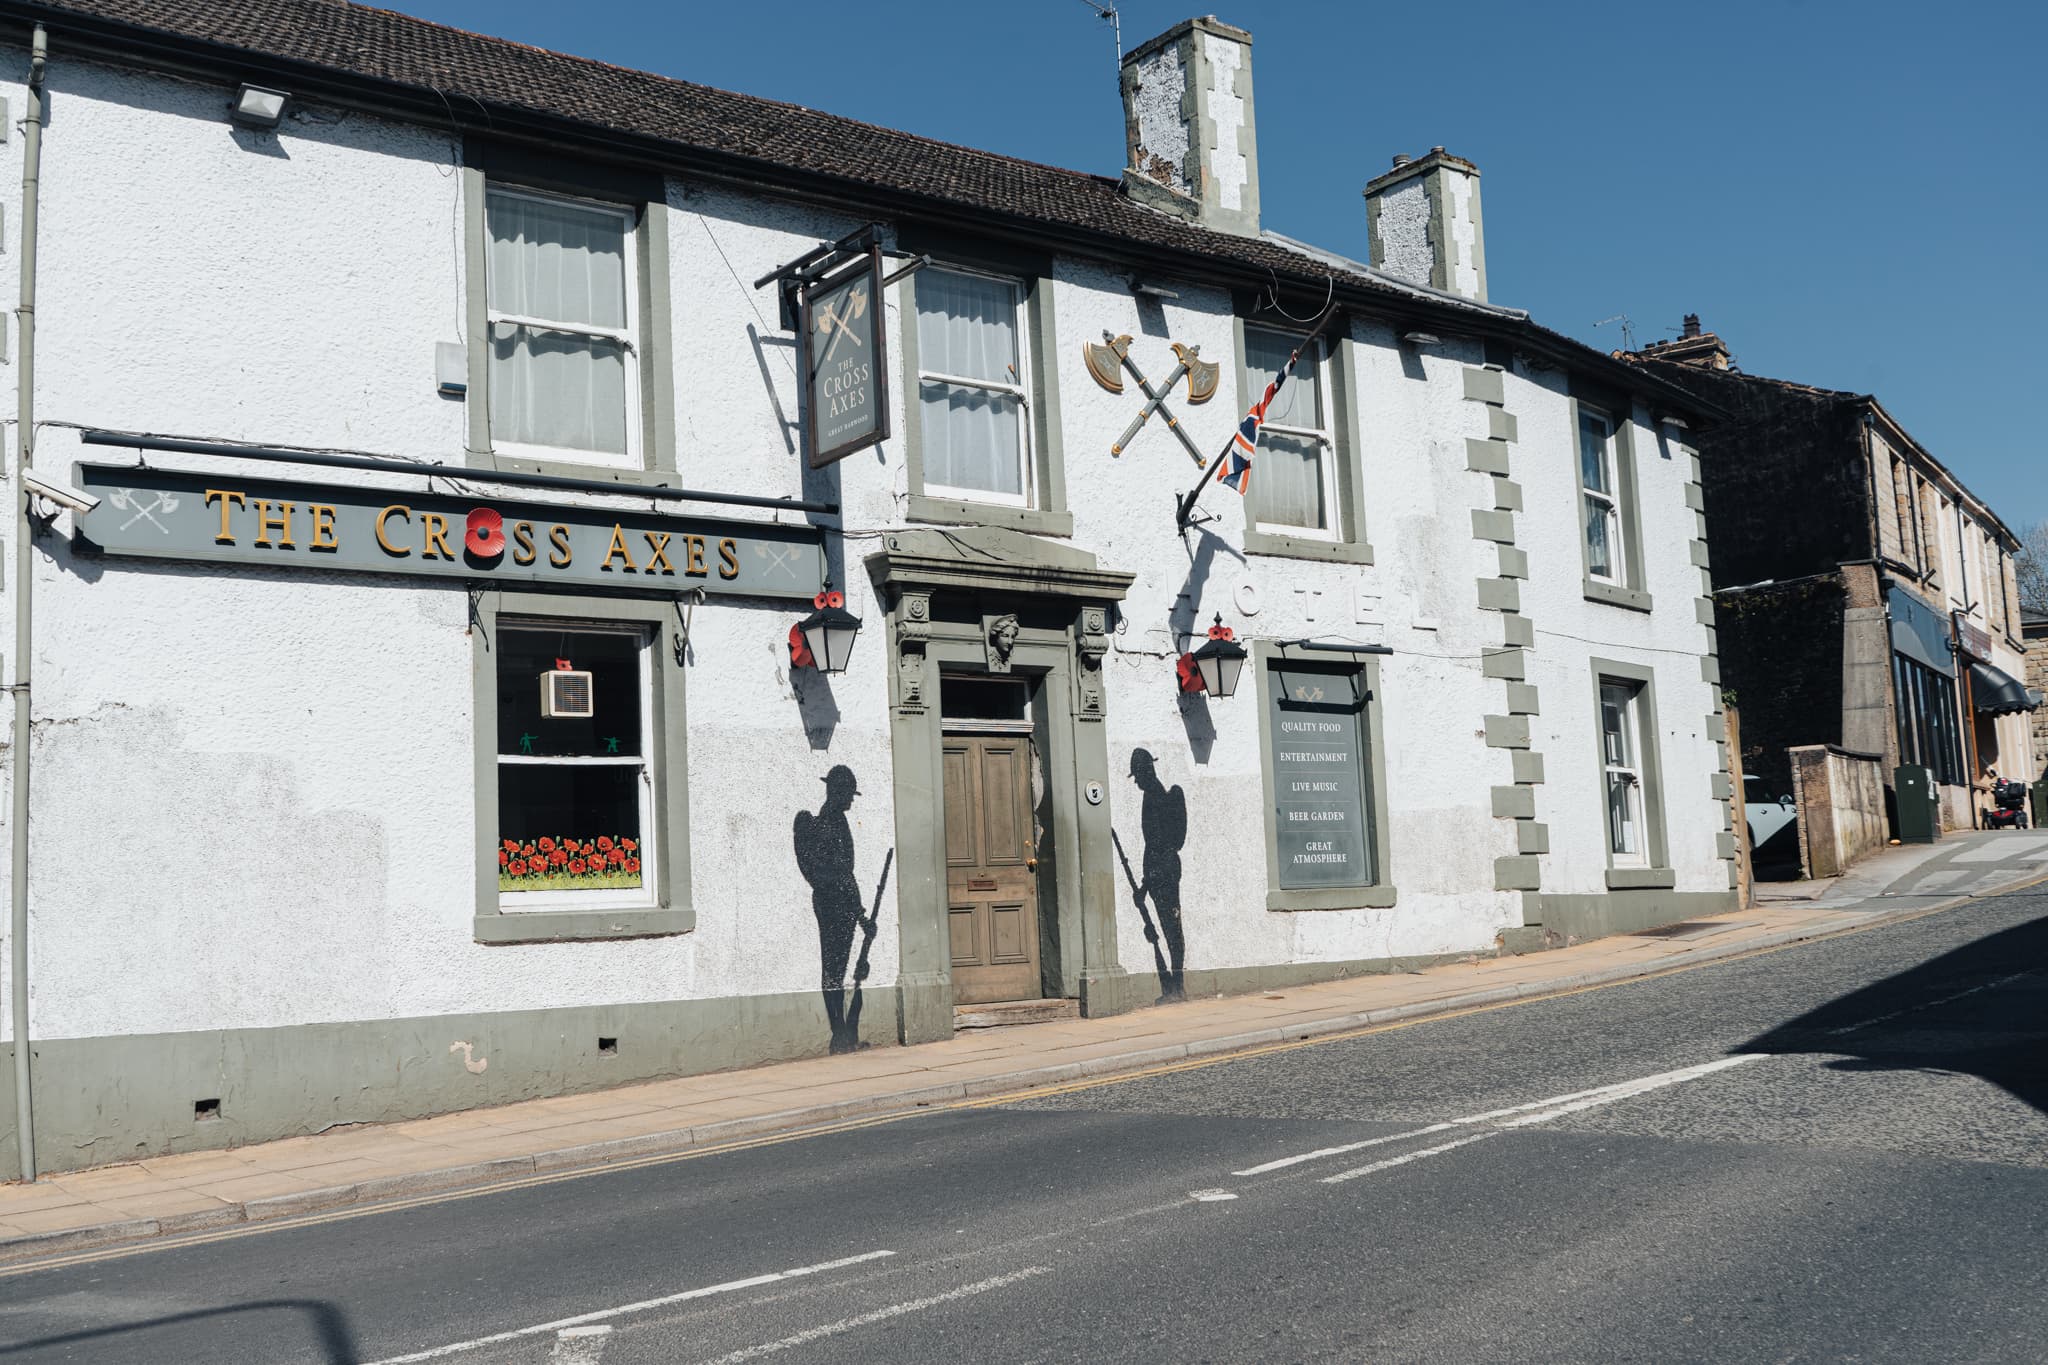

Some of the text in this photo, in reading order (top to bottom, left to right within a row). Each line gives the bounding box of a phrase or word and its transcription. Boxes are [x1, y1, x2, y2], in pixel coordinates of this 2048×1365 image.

[838, 357, 853, 373] THE
[824, 363, 868, 398] CROSS
[829, 387, 865, 418] AXES
[205, 489, 739, 577] THE CRSS AXES
[1281, 722, 1341, 733] QUALITY FOOD
[1280, 752, 1348, 762] ENTERTAINMENT
[1292, 782, 1339, 792] LIVE MUSIC
[1289, 811, 1344, 821] BEER GARDEN
[1306, 842, 1332, 851] GREAT
[1293, 854, 1347, 864] ATMOSPHERE
